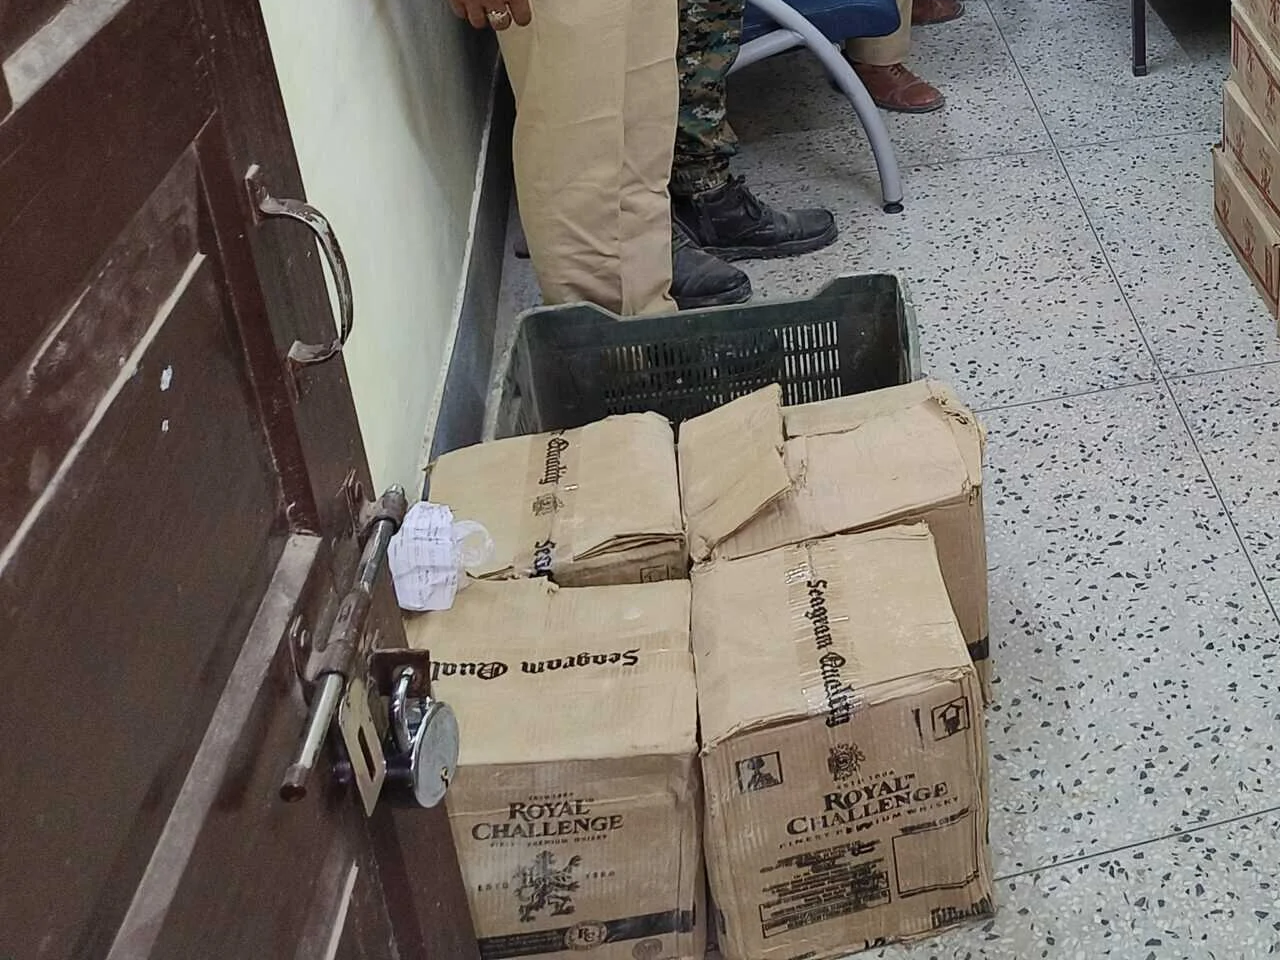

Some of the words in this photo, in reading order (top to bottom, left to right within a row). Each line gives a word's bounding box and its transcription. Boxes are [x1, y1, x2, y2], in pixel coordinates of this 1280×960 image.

[539, 437, 569, 485] Quality
[430, 660, 508, 681] Qual
[520, 648, 640, 674] Seagram
[804, 579, 833, 650] Seagram
[819, 651, 855, 729] Quality
[786, 781, 949, 835] CHALLENGE
[471, 814, 624, 841] CHALLENGE
